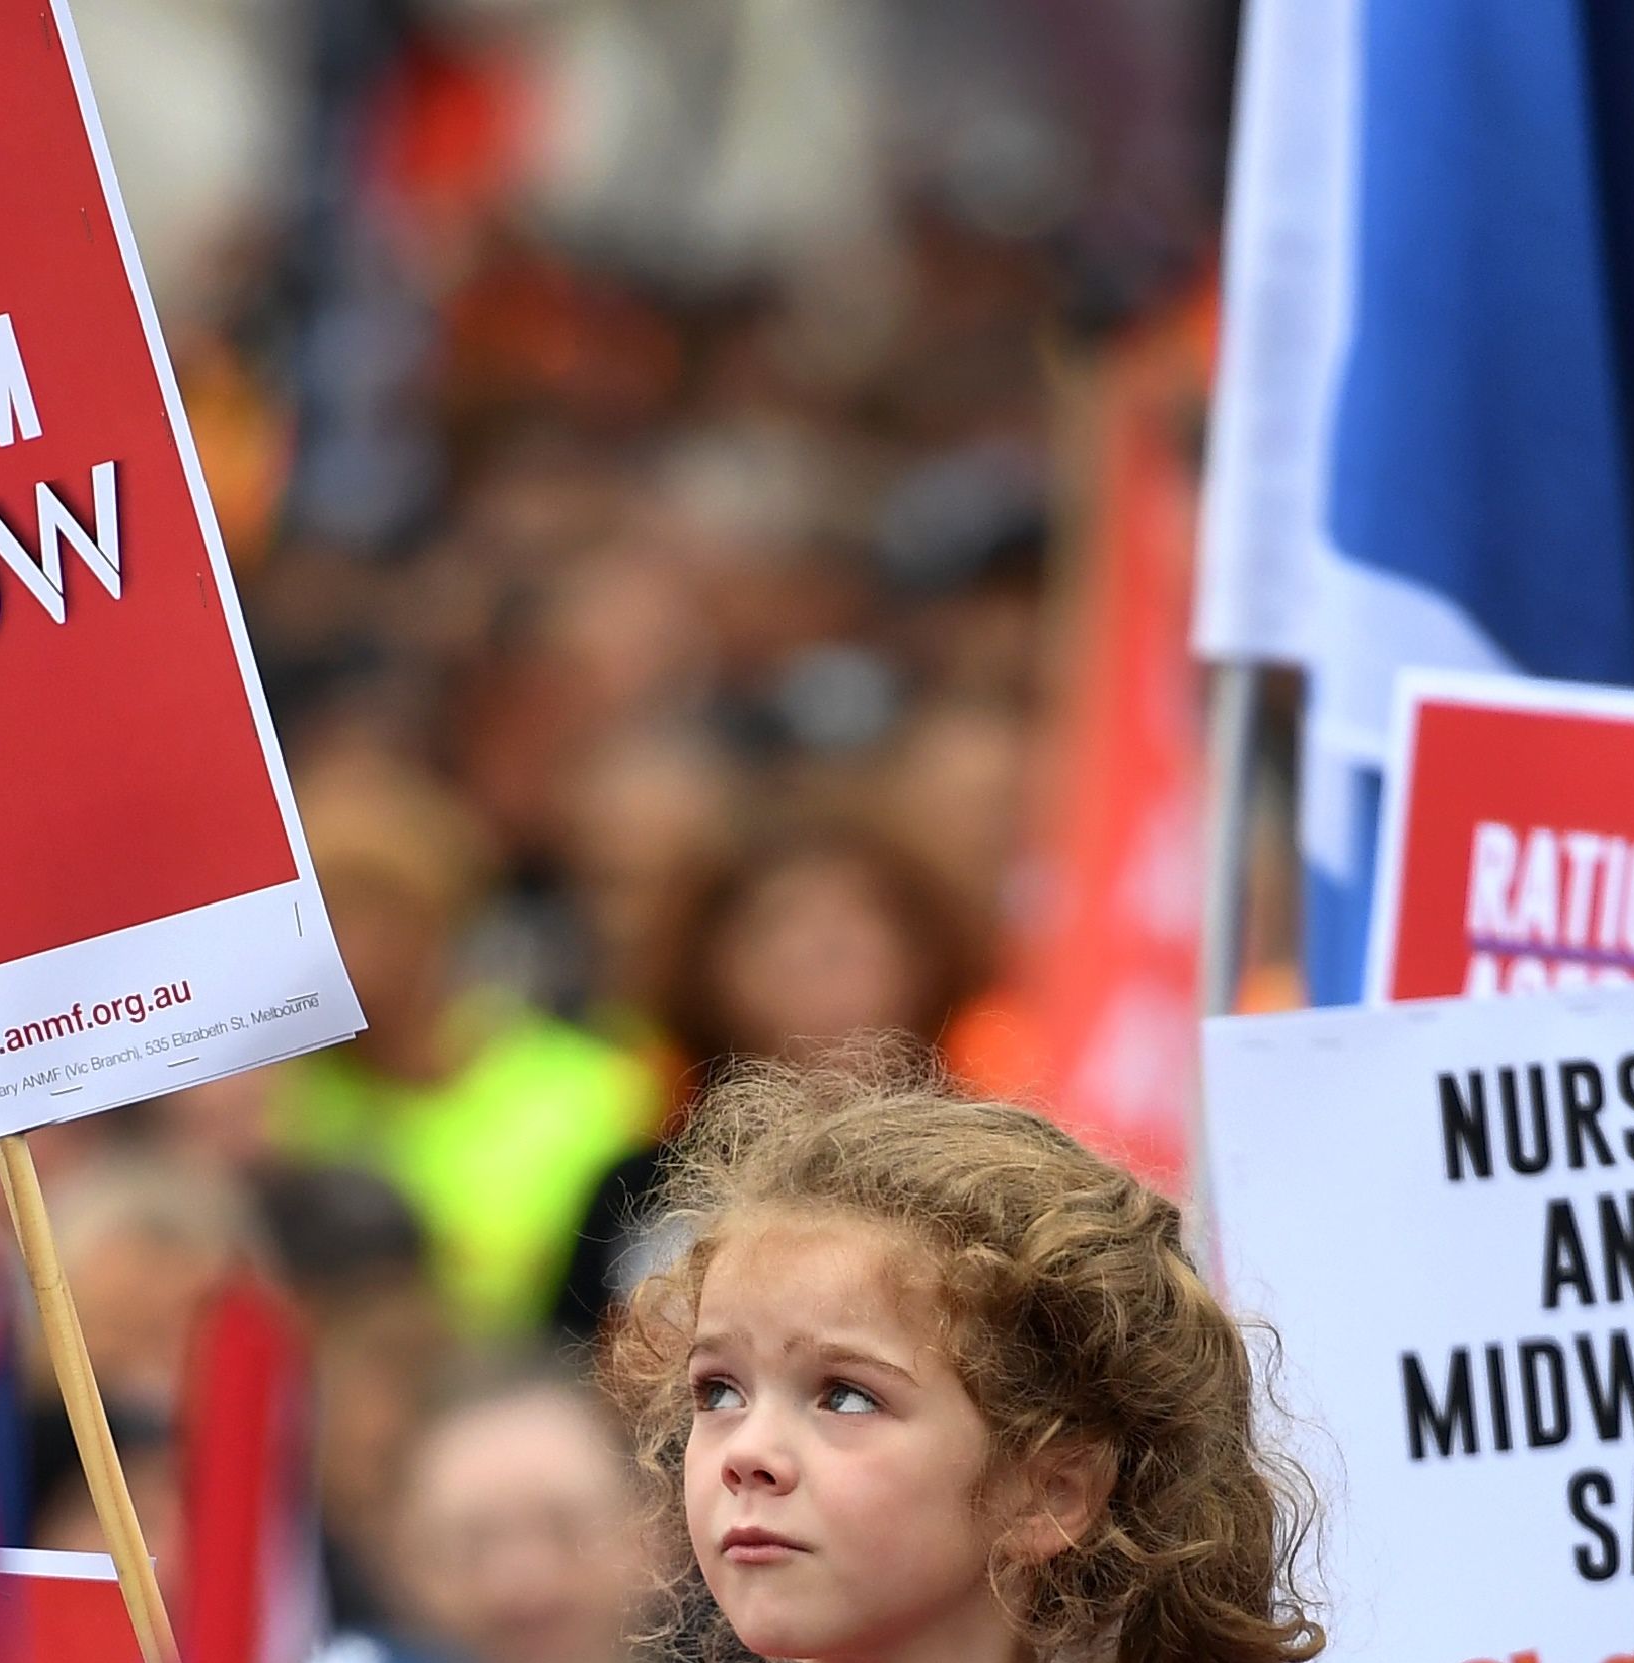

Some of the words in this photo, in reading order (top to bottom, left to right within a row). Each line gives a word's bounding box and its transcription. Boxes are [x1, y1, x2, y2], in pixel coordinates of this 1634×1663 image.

[22, 1069, 62, 1092] ANMF
[146, 1036, 170, 1056] 535
[172, 1021, 229, 1049] Elizabeth
[251, 995, 320, 1026] Melbourne
